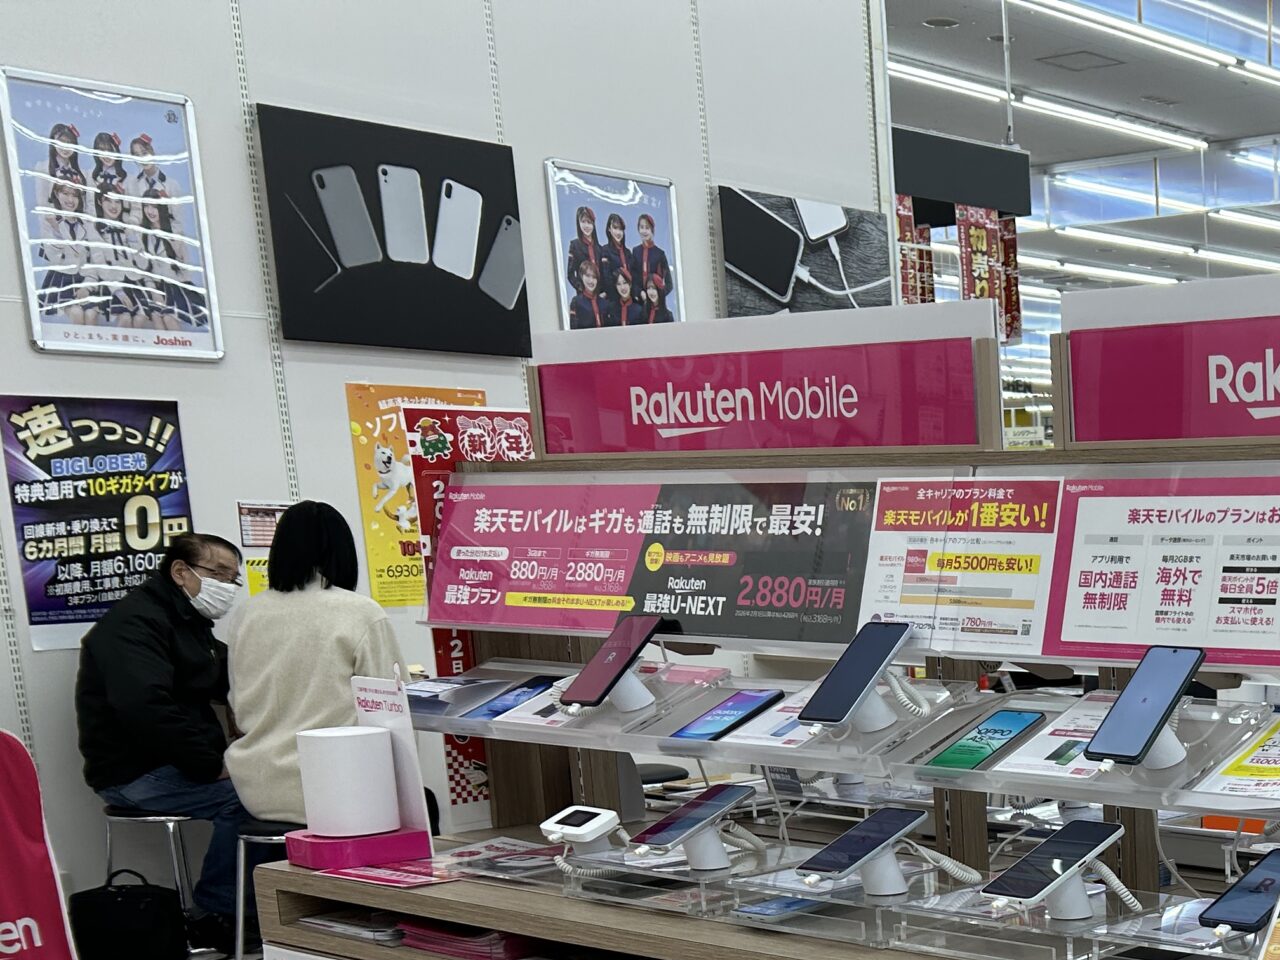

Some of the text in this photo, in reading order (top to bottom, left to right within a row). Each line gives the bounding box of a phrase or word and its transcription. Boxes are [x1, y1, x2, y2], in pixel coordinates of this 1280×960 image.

[153, 335, 192, 347] Joshin
[630, 375, 859, 430] Rakuten Mobile
[465, 432, 526, 455] 新年
[51, 452, 148, 477] BIGLOBE光
[916, 488, 1016, 500] 全キャリアのプラン料金で
[473, 503, 825, 537] 楽天モバイルはギガも通話も無制限で最安!
[90, 531, 121, 554] 月額
[665, 550, 730, 564] 映画もアニメも見放題
[936, 555, 1033, 572] 毎月5,500円も安い!
[1091, 554, 1131, 565] アプリ利用で
[1161, 555, 1202, 564] 毎月2GBまで
[459, 568, 493, 581] Rakuten
[667, 576, 706, 591] Rakuten
[1078, 570, 1139, 590] 国内通話
[1155, 567, 1202, 586] 海外で
[443, 584, 502, 606] 最強プラン
[737, 574, 845, 609] 2,880円/月
[1219, 576, 1279, 596] 毎日全員 5倍
[643, 592, 726, 617] 最強U-NEXT
[1082, 591, 1129, 611] 無制限
[1159, 587, 1193, 608] 無料
[1228, 606, 1264, 615] スマホ代の
[1215, 616, 1275, 626] お支払いに使える!
[356, 696, 403, 713] Rakuten Turbo
